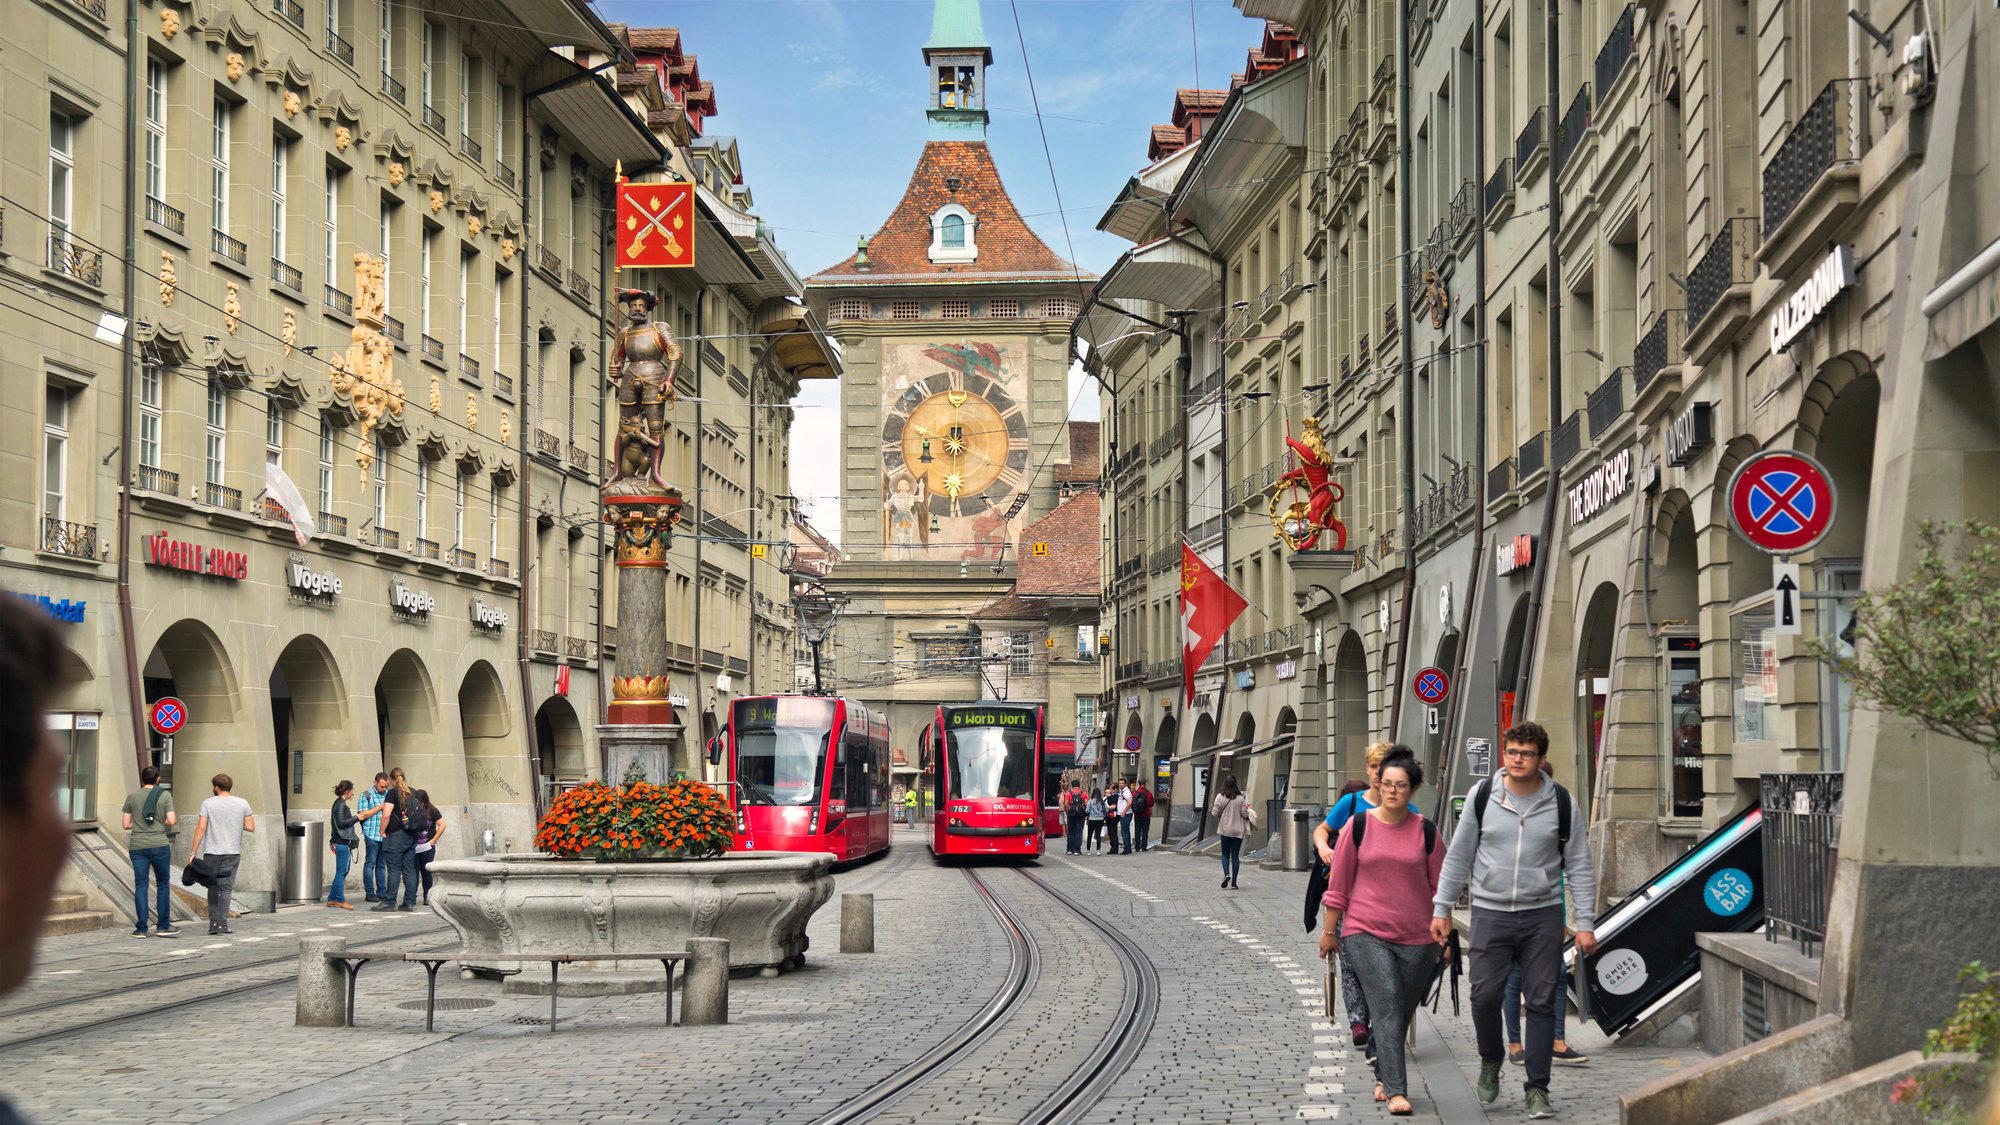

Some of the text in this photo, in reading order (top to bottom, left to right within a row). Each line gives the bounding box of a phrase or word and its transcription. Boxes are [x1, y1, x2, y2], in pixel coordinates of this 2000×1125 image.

[1771, 244, 1845, 355] CALZEDONIA
[1569, 483, 1584, 527] THE
[1584, 465, 1605, 518] BODY
[1605, 448, 1629, 502] SHOP
[149, 530, 248, 580] VÖGELE SHOES
[293, 563, 342, 596] Vögele
[396, 585, 435, 614] Vögele
[476, 602, 508, 628] Vögele
[953, 712, 1026, 724] 6 Worb Dorf
[1709, 873, 1737, 900] ÄSS
[1720, 883, 1750, 912] BAR
[1605, 956, 1634, 980] GMÜES
[1610, 962, 1638, 985] GARTE
